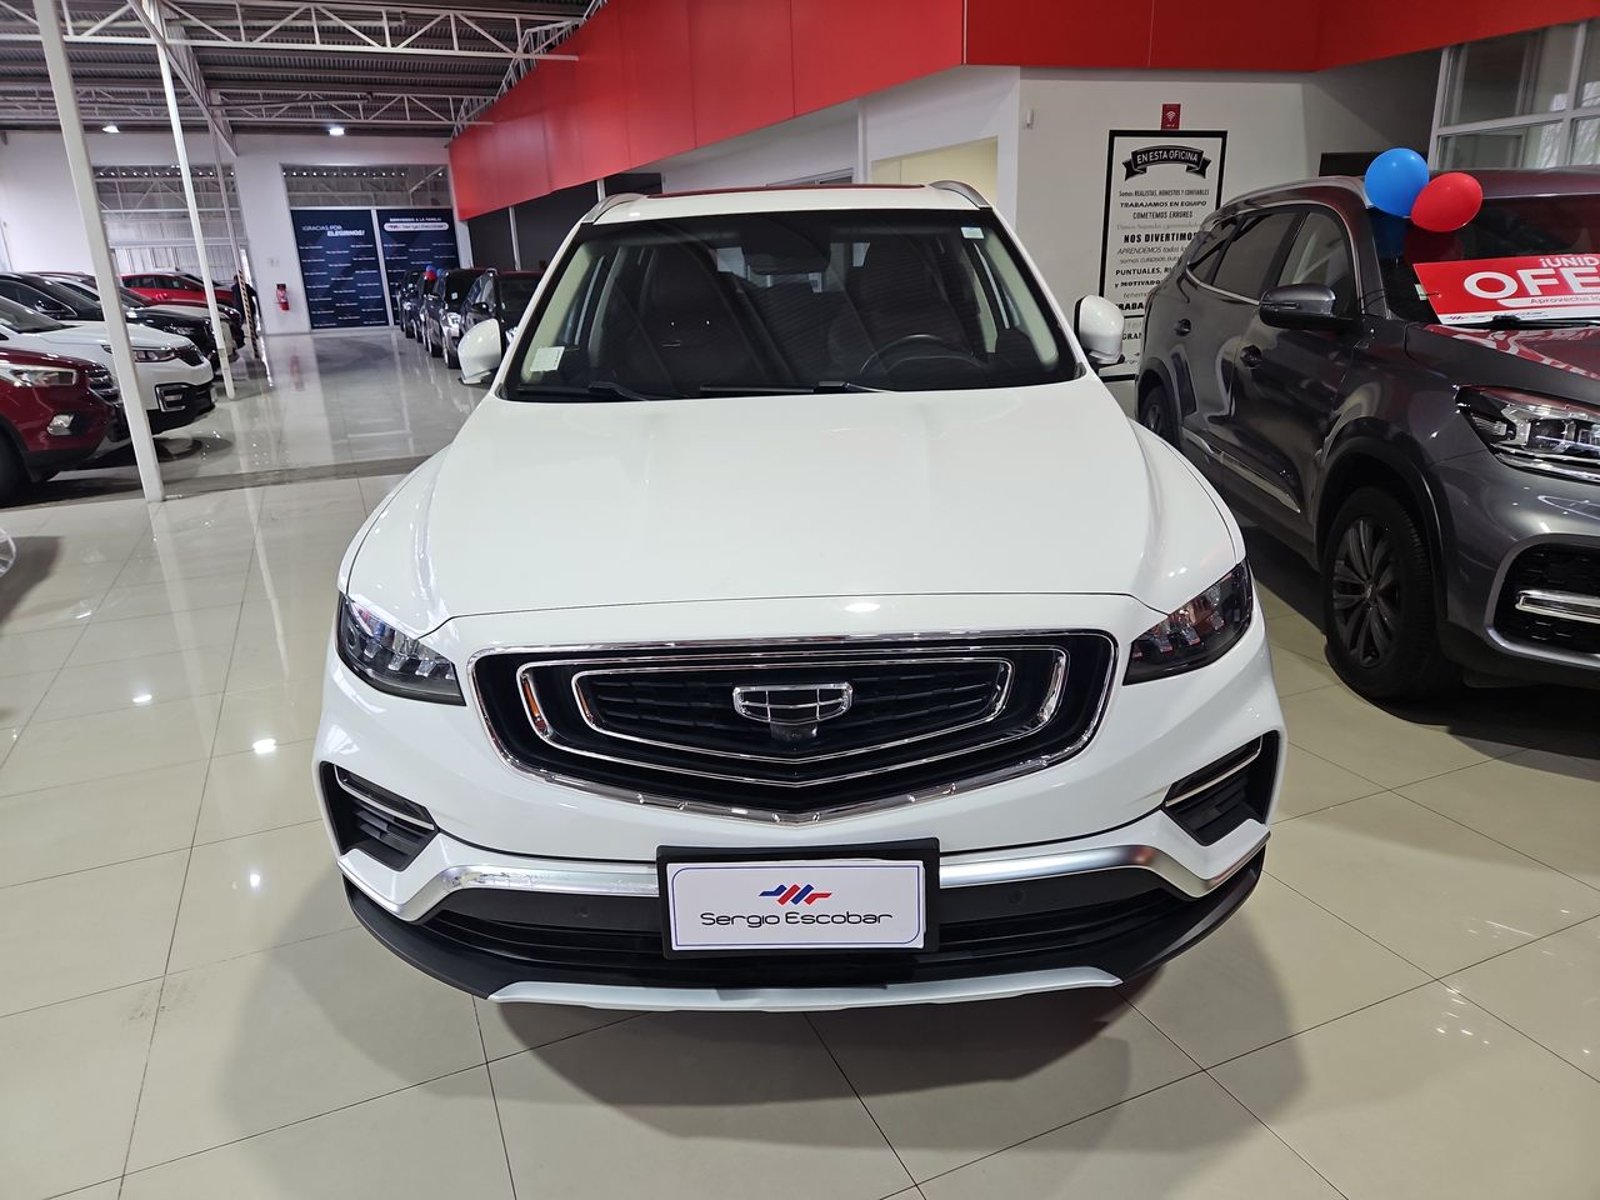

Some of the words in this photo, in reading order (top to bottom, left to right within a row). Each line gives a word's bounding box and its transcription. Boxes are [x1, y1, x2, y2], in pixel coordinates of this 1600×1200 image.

[1137, 154, 1148, 164] EN
[1149, 151, 1168, 161] ESTA
[1169, 150, 1198, 161] OFICINA
[1133, 211, 1167, 219] COMETEMOS
[1169, 210, 1193, 218] ERRORES
[1124, 234, 1142, 243] NOS
[1115, 267, 1162, 276] PUNTUALES,
[1115, 302, 1145, 311] RABA
[700, 912, 780, 929] Sergio
[785, 911, 893, 925] Escobar
